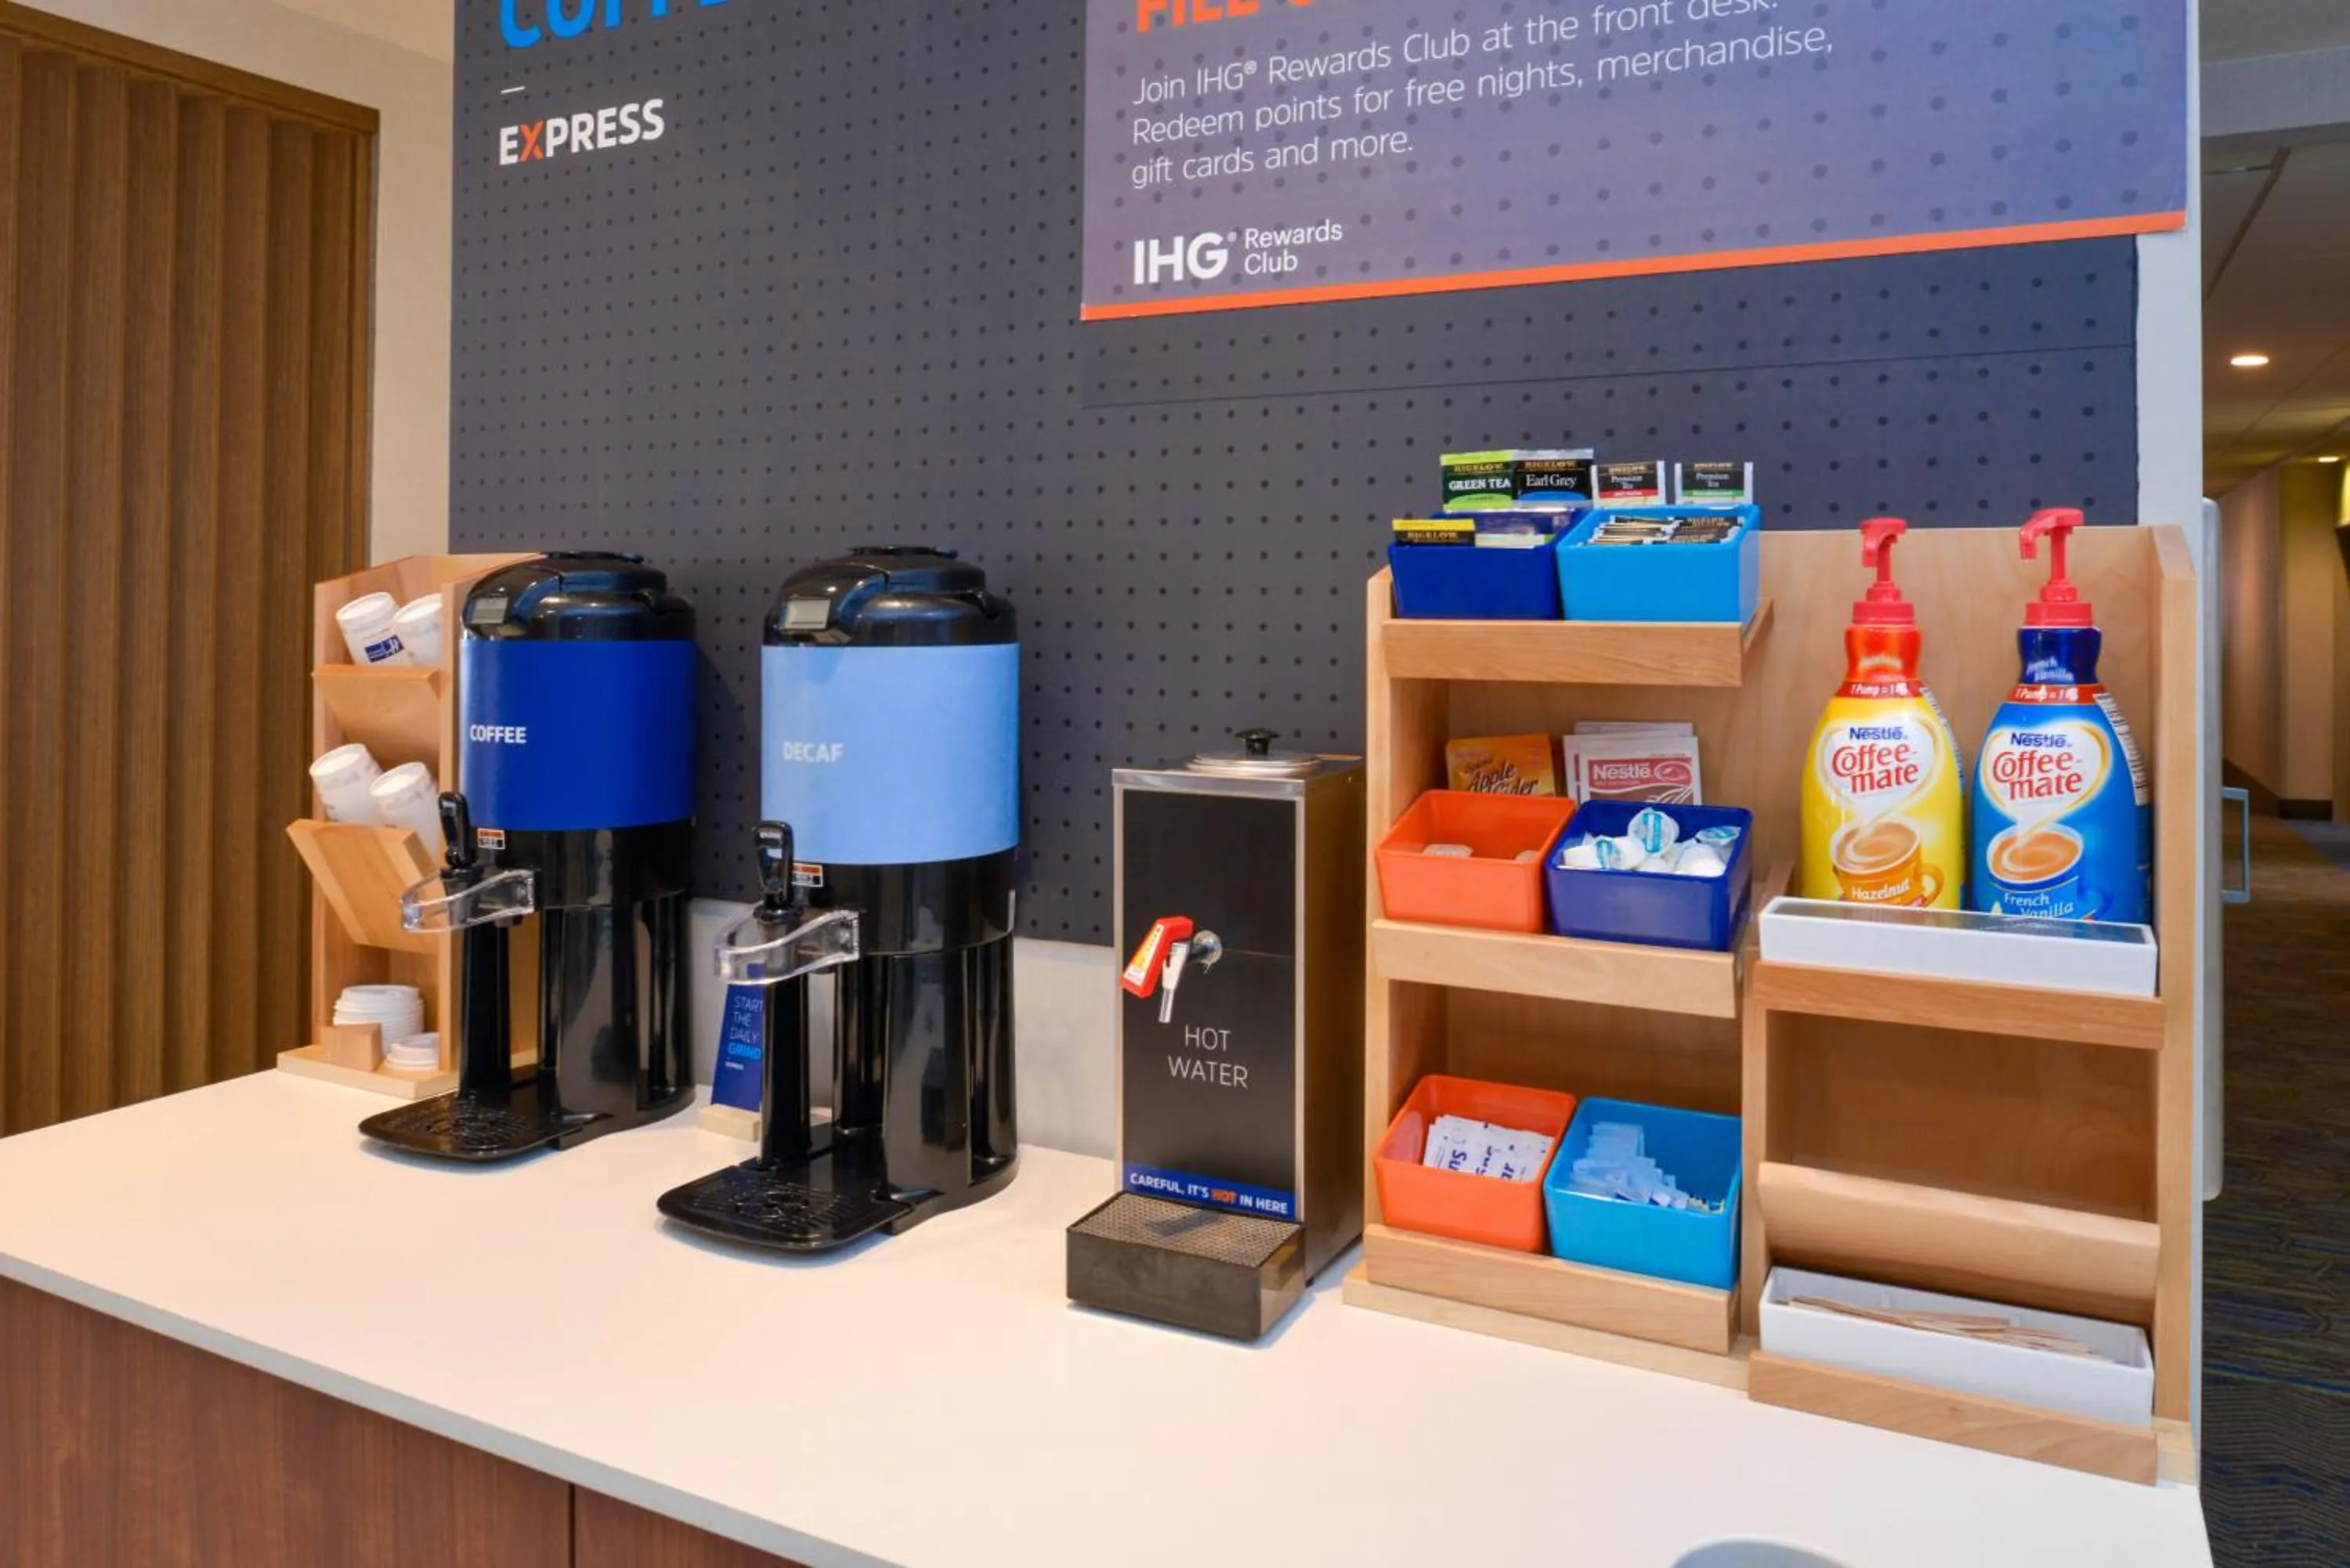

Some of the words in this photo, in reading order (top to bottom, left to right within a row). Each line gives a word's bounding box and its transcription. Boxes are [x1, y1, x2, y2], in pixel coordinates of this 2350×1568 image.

[1132, 76, 1185, 105] Join
[1269, 42, 1391, 83] Rewards
[1404, 28, 1470, 63] Club
[1483, 26, 1513, 52] at
[1525, 15, 1579, 45] the
[1592, 0, 1673, 35] front
[1133, 110, 1244, 145] Redeem
[1256, 95, 1342, 132] points
[1354, 86, 1394, 114] for
[1405, 79, 1465, 107] free
[1478, 61, 1583, 98] nights,
[1597, 26, 1832, 81] merchandise,
[498, 98, 665, 165] EXPRESS
[1132, 159, 1173, 190] gift
[1183, 147, 1254, 180] cards
[1265, 137, 1318, 168] and
[1331, 130, 1413, 157] more.
[1244, 219, 1343, 249] Rewards
[1244, 250, 1298, 275] Club
[1449, 479, 1485, 491] GREEN
[1488, 478, 1512, 489] TEA
[1526, 474, 1549, 486] Earl
[1549, 475, 1576, 488] Grey
[470, 724, 527, 743] COFFEE
[783, 741, 844, 763] DECAF
[1852, 764, 1918, 793] mate
[2010, 772, 2082, 800] mate
[1851, 878, 1910, 899] Hazelnut
[2005, 892, 2050, 906] French
[1185, 1024, 1231, 1052] HOT
[1167, 1054, 1248, 1089] WATER
[1130, 1173, 1185, 1195] CAREFUL,
[1188, 1183, 1209, 1199] IT'S
[1239, 1194, 1253, 1207] IN
[1256, 1197, 1289, 1214] HERE
